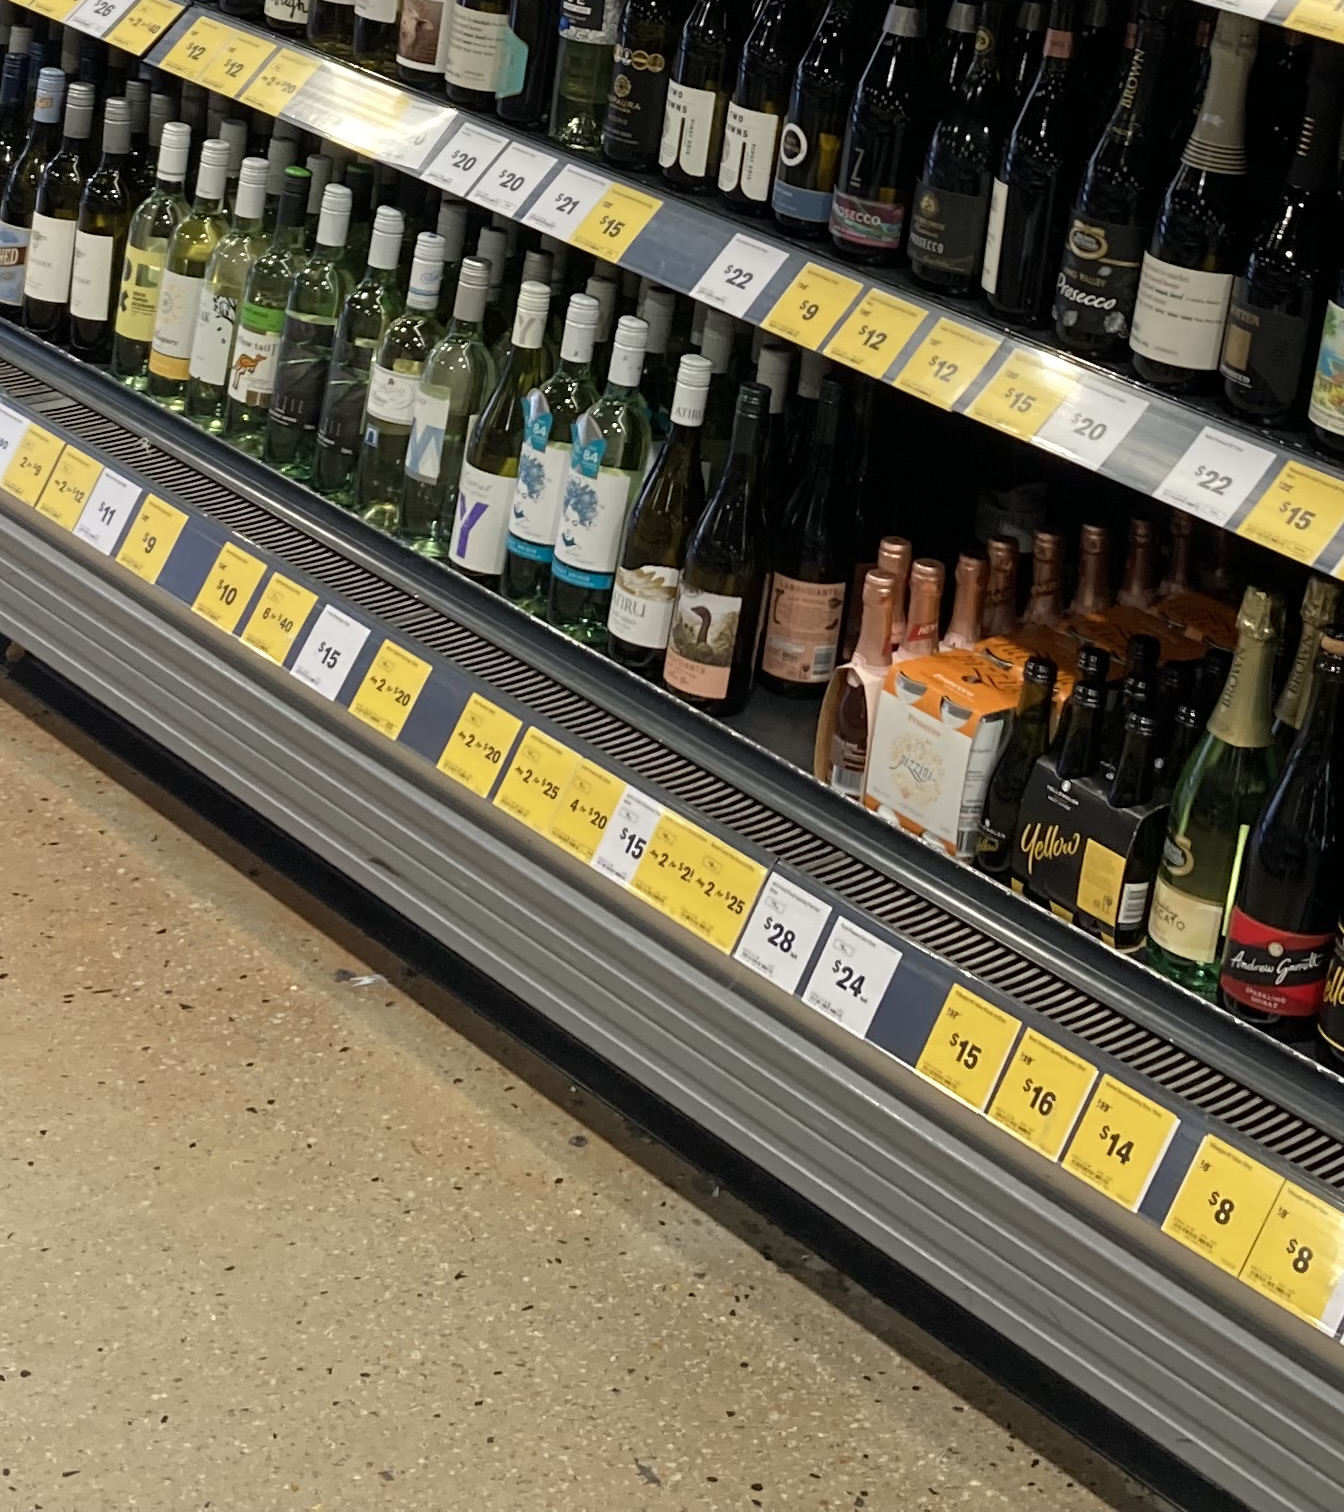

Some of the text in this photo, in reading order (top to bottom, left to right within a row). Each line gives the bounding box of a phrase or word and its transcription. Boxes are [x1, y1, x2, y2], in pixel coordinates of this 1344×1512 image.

[1122, 48, 1146, 109] BROWN
[600, 215, 626, 238] $15
[724, 264, 754, 291] $22
[799, 300, 819, 321] $9
[858, 325, 887, 351] $12
[928, 354, 959, 384] $12
[1005, 387, 1036, 414] $15
[1070, 413, 1108, 442] $20
[1195, 465, 1233, 496] $22
[1279, 500, 1316, 530] $15
[142, 533, 157, 553] $9
[217, 579, 237, 606] $10
[318, 641, 340, 669] $15
[1222, 647, 1246, 708] BROWN
[620, 828, 646, 860] $15
[1021, 823, 1080, 875] Yellow
[764, 917, 796, 953] $28
[832, 960, 865, 997] $24
[949, 1033, 981, 1070] $15
[1022, 1078, 1056, 1116] $16
[1099, 1125, 1133, 1166] $14
[1208, 1191, 1235, 1226] $8
[1287, 1238, 1313, 1274] $8
